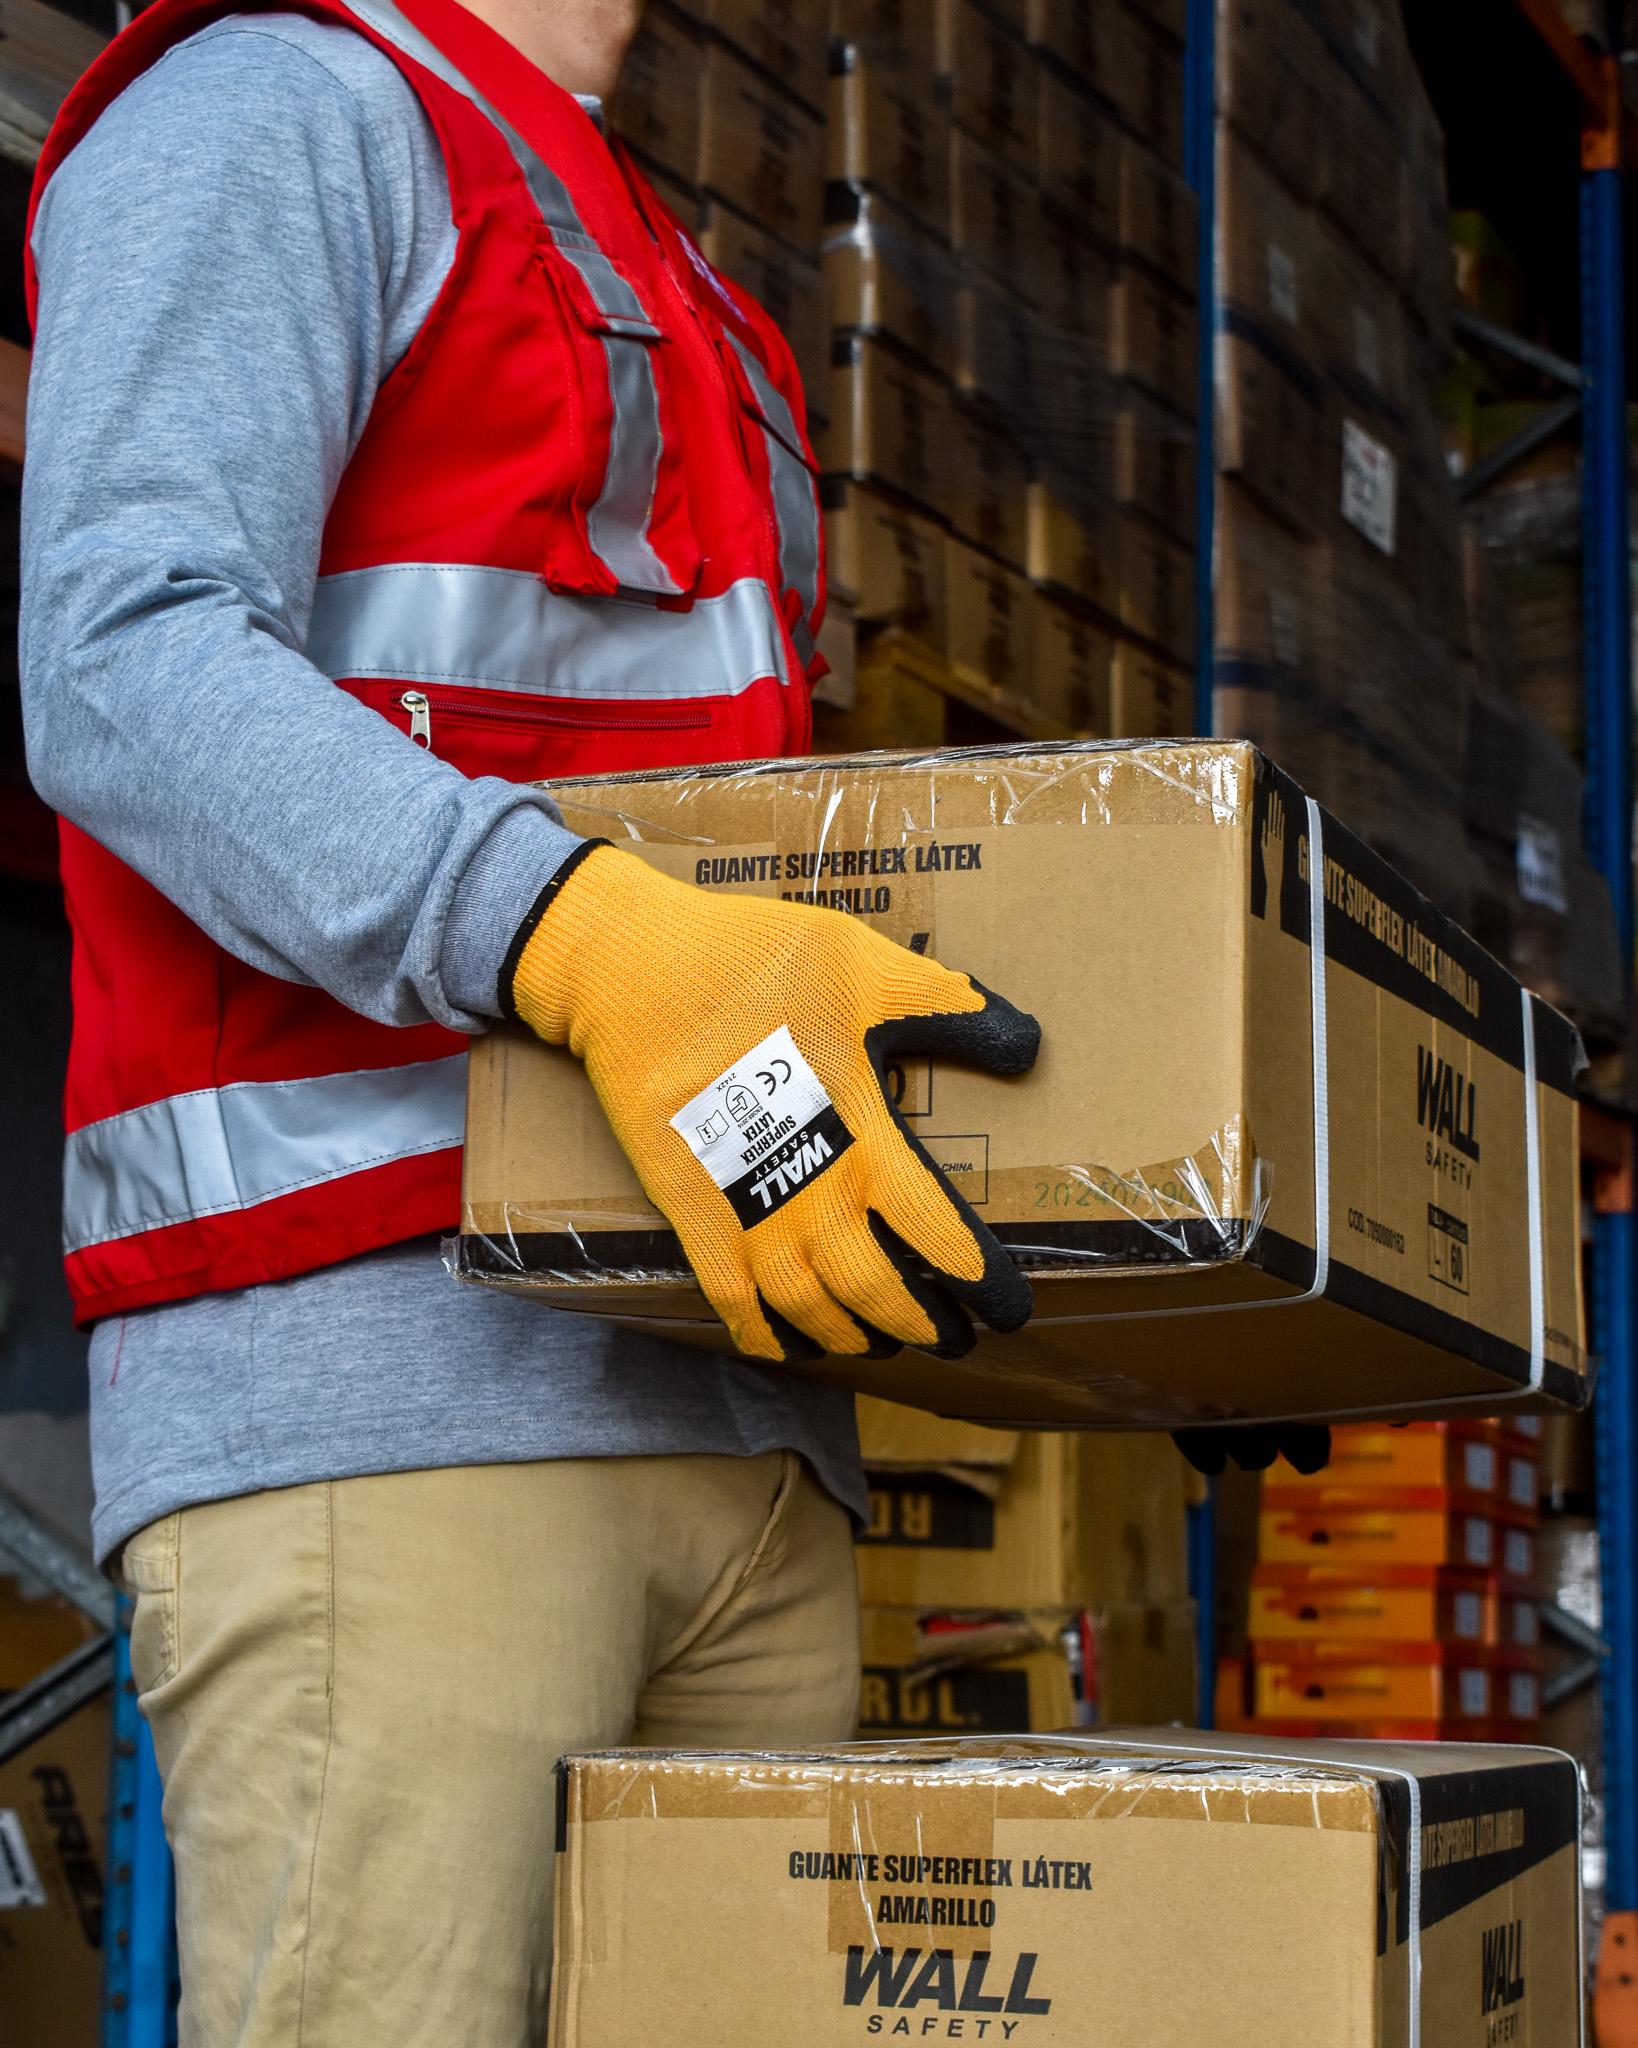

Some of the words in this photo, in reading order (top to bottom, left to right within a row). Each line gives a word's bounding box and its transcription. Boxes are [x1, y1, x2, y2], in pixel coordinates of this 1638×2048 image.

[695, 855, 781, 884] GUANTE
[785, 847, 906, 880] SUPERFLEX
[914, 841, 982, 872] LÁTEX
[1298, 834, 1345, 911] GNTE
[716, 1072, 737, 1092] 2142X
[1417, 1044, 1480, 1163] WALL
[740, 1114, 797, 1166] SUPERFLEX
[742, 1111, 776, 1144] LÁTEX
[750, 1131, 834, 1209] WALL
[755, 1131, 809, 1180] SAFETY
[942, 1163, 973, 1172] CHINA
[1425, 1141, 1472, 1190] SAFETY
[788, 1851, 879, 1881] GUANTE
[883, 1855, 1013, 1887] SUPERFLEX
[1021, 1855, 1093, 1890] LÁTEX
[877, 1895, 996, 1928] AMARILLO
[843, 1945, 1051, 2015] WALL
[1482, 1919, 1524, 2016] WALL
[867, 2014, 1019, 2040] SAFETY
